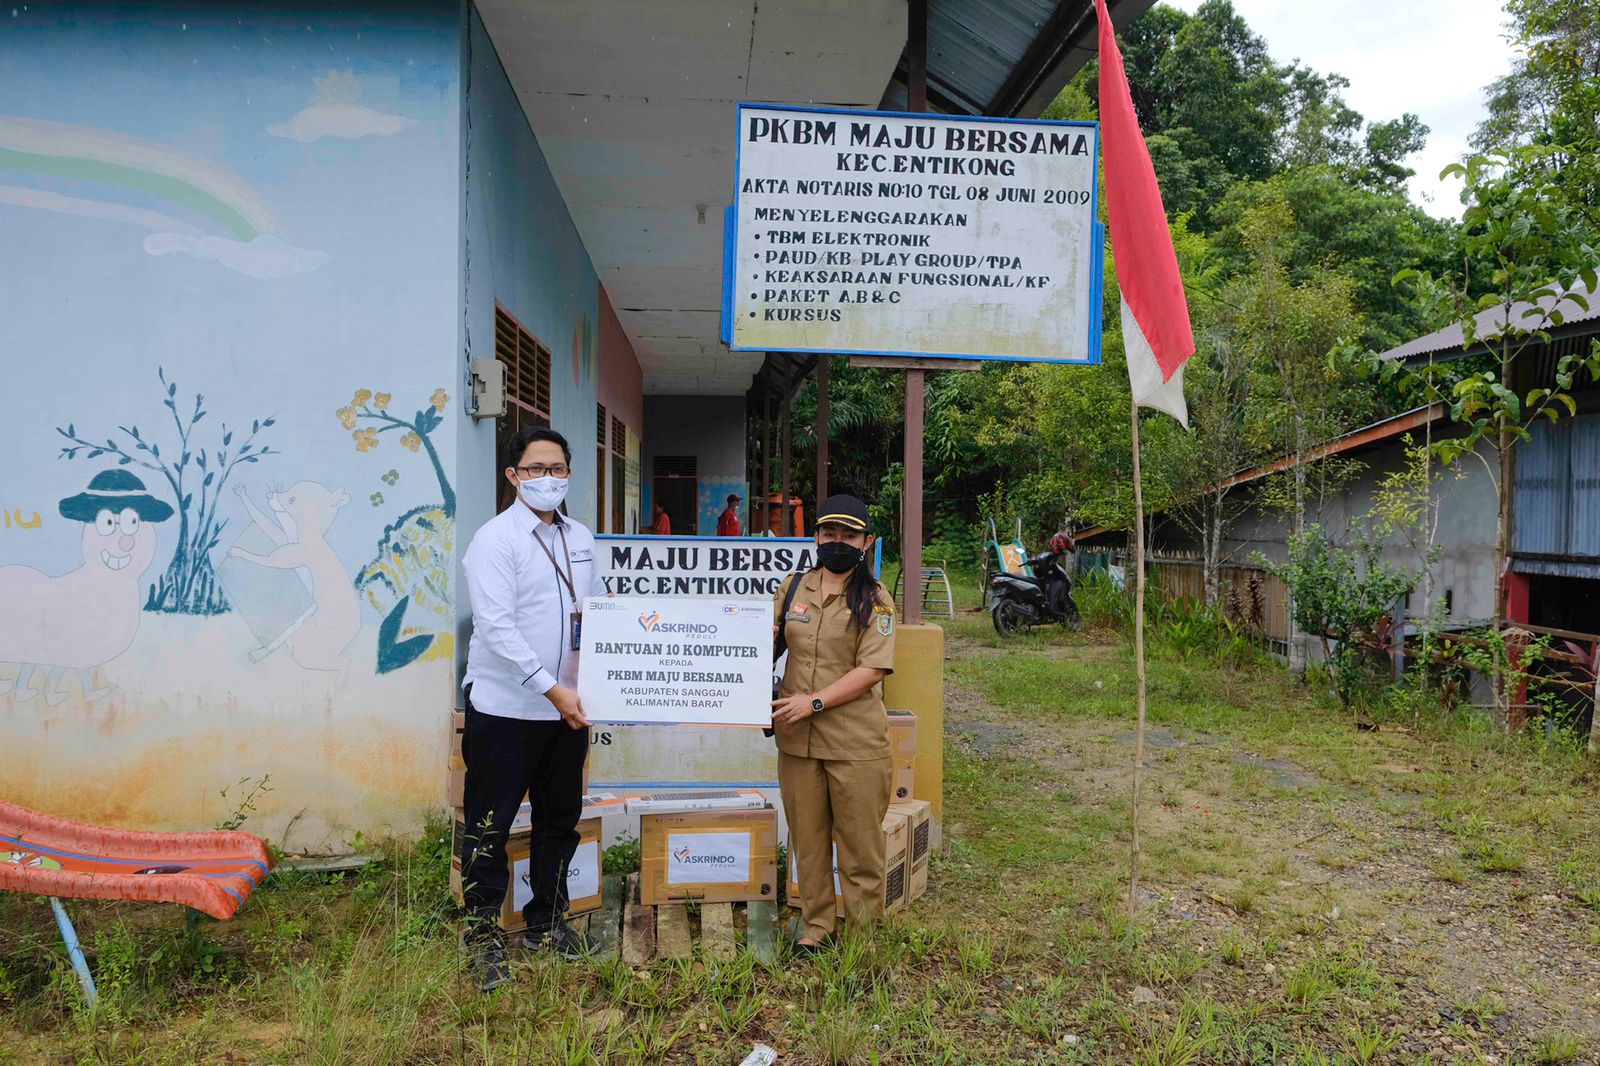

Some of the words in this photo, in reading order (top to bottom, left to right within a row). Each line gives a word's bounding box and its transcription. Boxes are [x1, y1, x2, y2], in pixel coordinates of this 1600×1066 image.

[748, 117, 837, 146] PKBM
[849, 122, 936, 150] MAJU
[945, 127, 1089, 156] BERSAMA
[836, 153, 1016, 177] KEC.ENTIKONG
[742, 178, 790, 194] AKTA
[796, 180, 873, 197] NOTARIS
[928, 185, 962, 200] TGL
[966, 186, 989, 201] 08
[996, 187, 1036, 203] JUNI
[1043, 189, 1090, 205] 2009
[754, 207, 968, 227] MENYELENGGARAKAN
[766, 230, 806, 244] TBM
[812, 231, 931, 247] ELEKTRONIK
[765, 250, 850, 265] PAUD/KB
[861, 252, 911, 266] PLAY
[914, 253, 1022, 269] GROUP/TPA
[765, 270, 892, 285] KEAKSARAAN
[898, 272, 1050, 288] FUNGSIONAL/KF
[764, 289, 830, 303] PAKET
[764, 308, 841, 322] KURSUS
[611, 546, 699, 571] MAJU
[708, 548, 814, 571] BERSA
[651, 623, 718, 634] ASKRINDO
[594, 642, 663, 655] BANTUAN
[666, 644, 680, 656] 10
[683, 644, 758, 658] KOMPUTER
[659, 659, 693, 667] KEPADA
[607, 670, 643, 681] PKBM
[645, 671, 680, 684] MAJU
[682, 672, 744, 684] BERSAMA
[620, 687, 679, 696] KABUPATEN
[681, 688, 730, 697] SANGGAU
[625, 698, 688, 707] KALIMANTAN
[691, 700, 724, 708] BARAT
[684, 855, 735, 864] ASKRINDO
